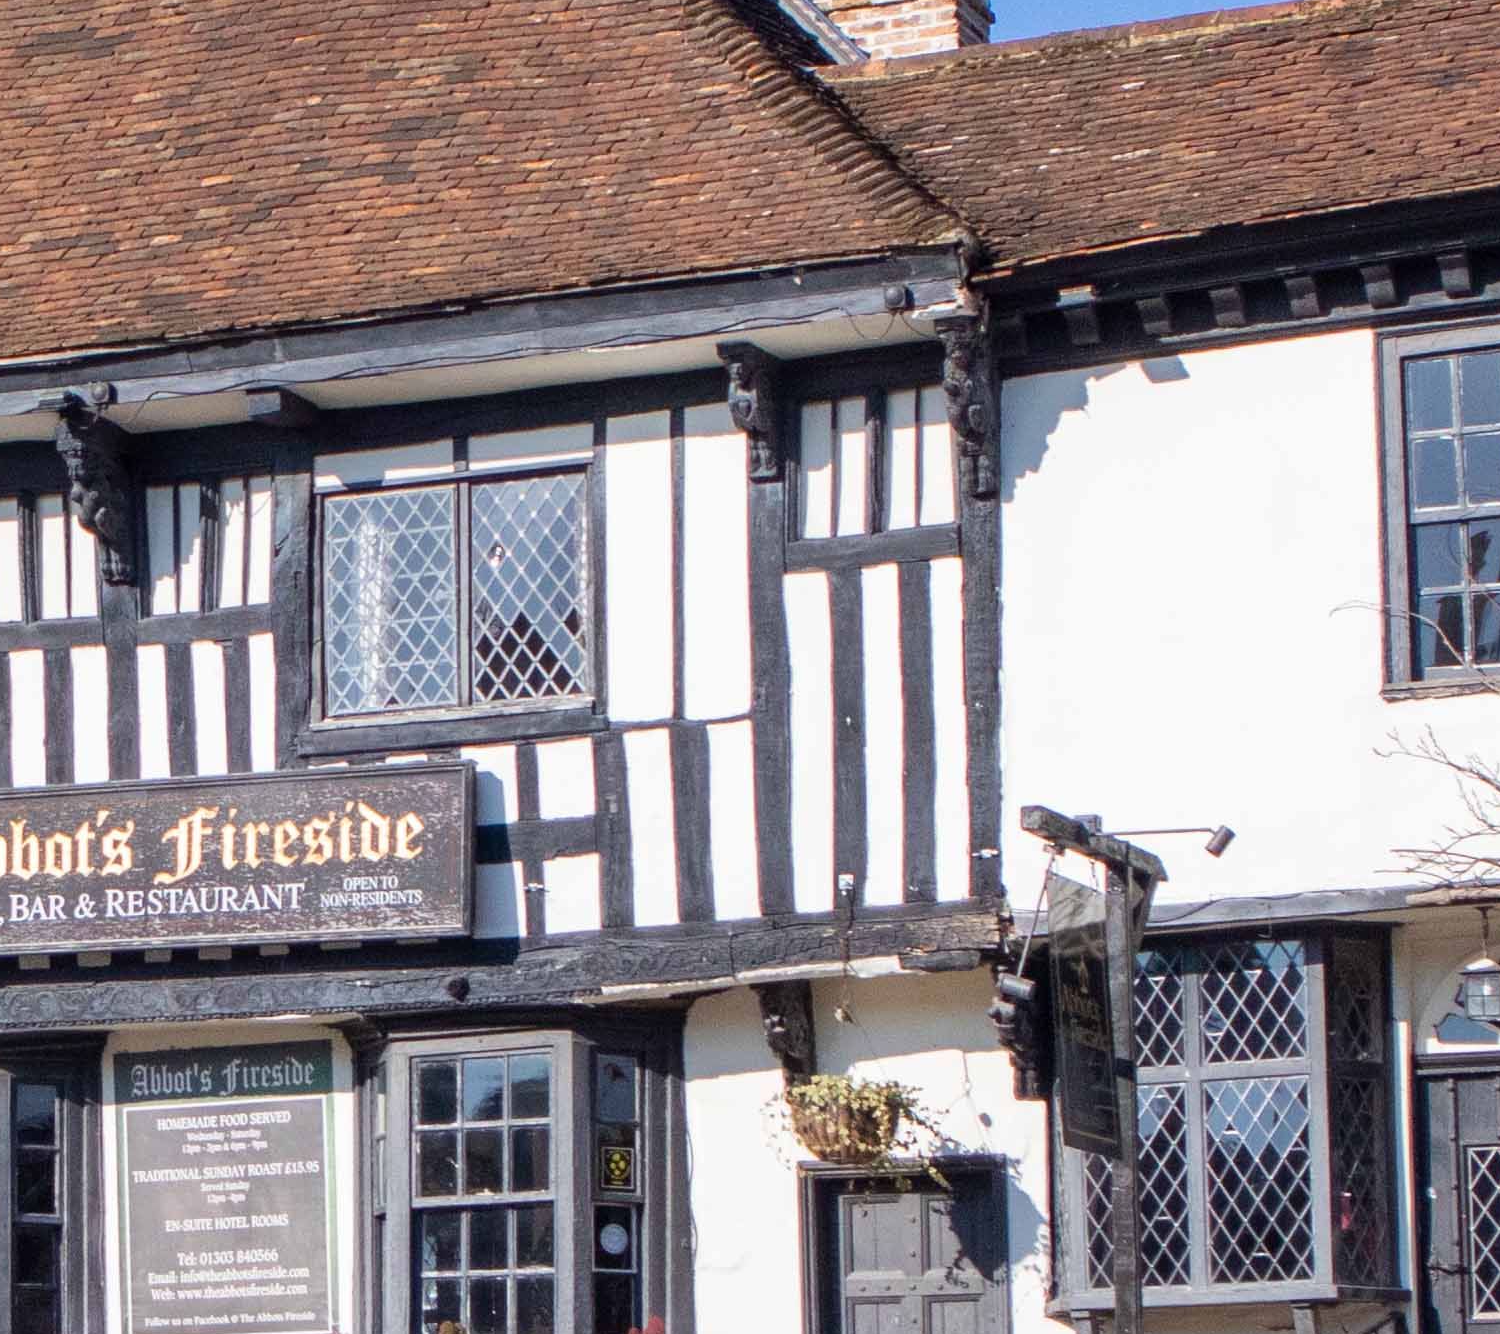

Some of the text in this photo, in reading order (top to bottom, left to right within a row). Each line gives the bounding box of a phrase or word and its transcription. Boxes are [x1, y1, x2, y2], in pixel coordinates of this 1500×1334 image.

[153, 799, 425, 885] Fireside
[343, 875, 399, 892] OPEN TO
[9, 894, 67, 922] BAR
[74, 892, 97, 918] &
[105, 883, 305, 917] RESTAURANT
[320, 889, 423, 909] NON-RESIDENTS
[131, 1057, 315, 1097] Abbot's Fireside
[157, 1111, 292, 1131] HOMEMADE FOOD SERVED
[132, 1168, 201, 1183] TRADITIONAL
[203, 1165, 246, 1180] SUNDAY
[248, 1163, 283, 1177] ROAST
[165, 1214, 289, 1233] EN-SUITE HOTEL ROOMS
[177, 1251, 197, 1266] Tel:
[199, 1250, 234, 1266] 01303
[148, 1271, 178, 1285] Email:
[151, 1287, 176, 1300] Web:
